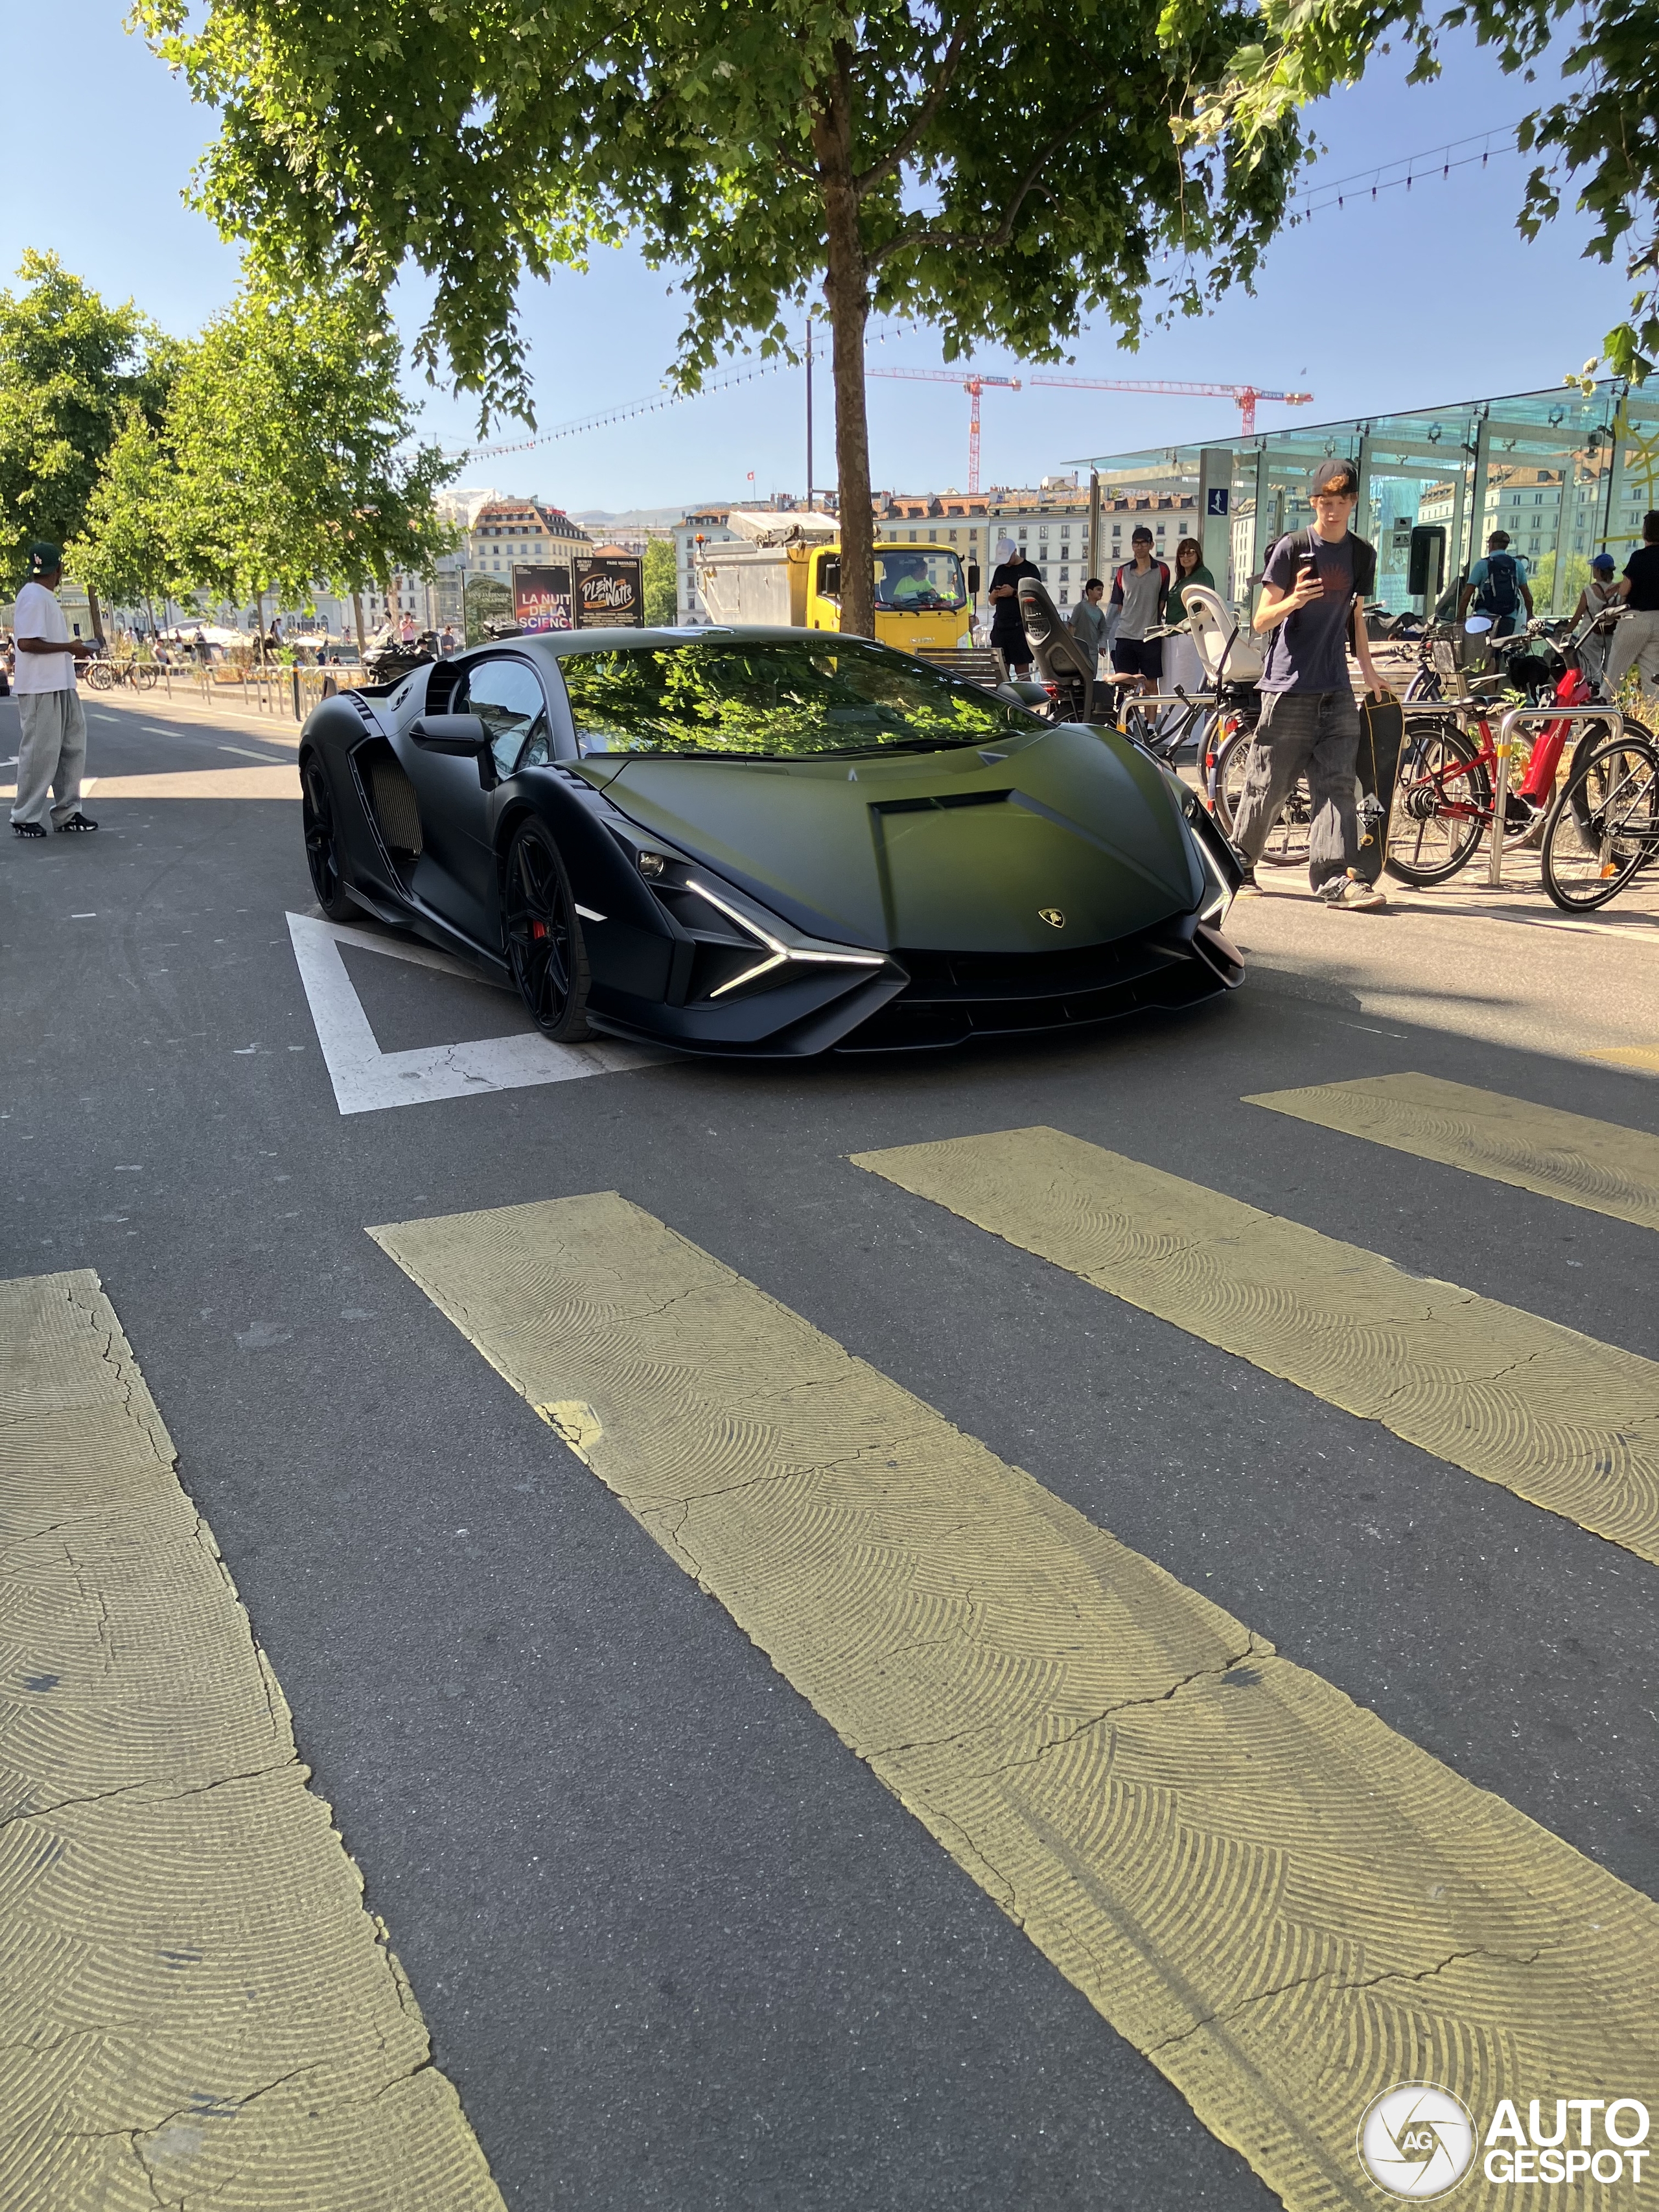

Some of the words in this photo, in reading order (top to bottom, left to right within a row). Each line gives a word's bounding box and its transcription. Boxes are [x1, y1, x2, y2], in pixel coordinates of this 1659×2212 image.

[522, 593, 539, 605] LA
[541, 594, 571, 605] NUIT
[529, 605, 547, 616] DE
[550, 605, 566, 616] LA
